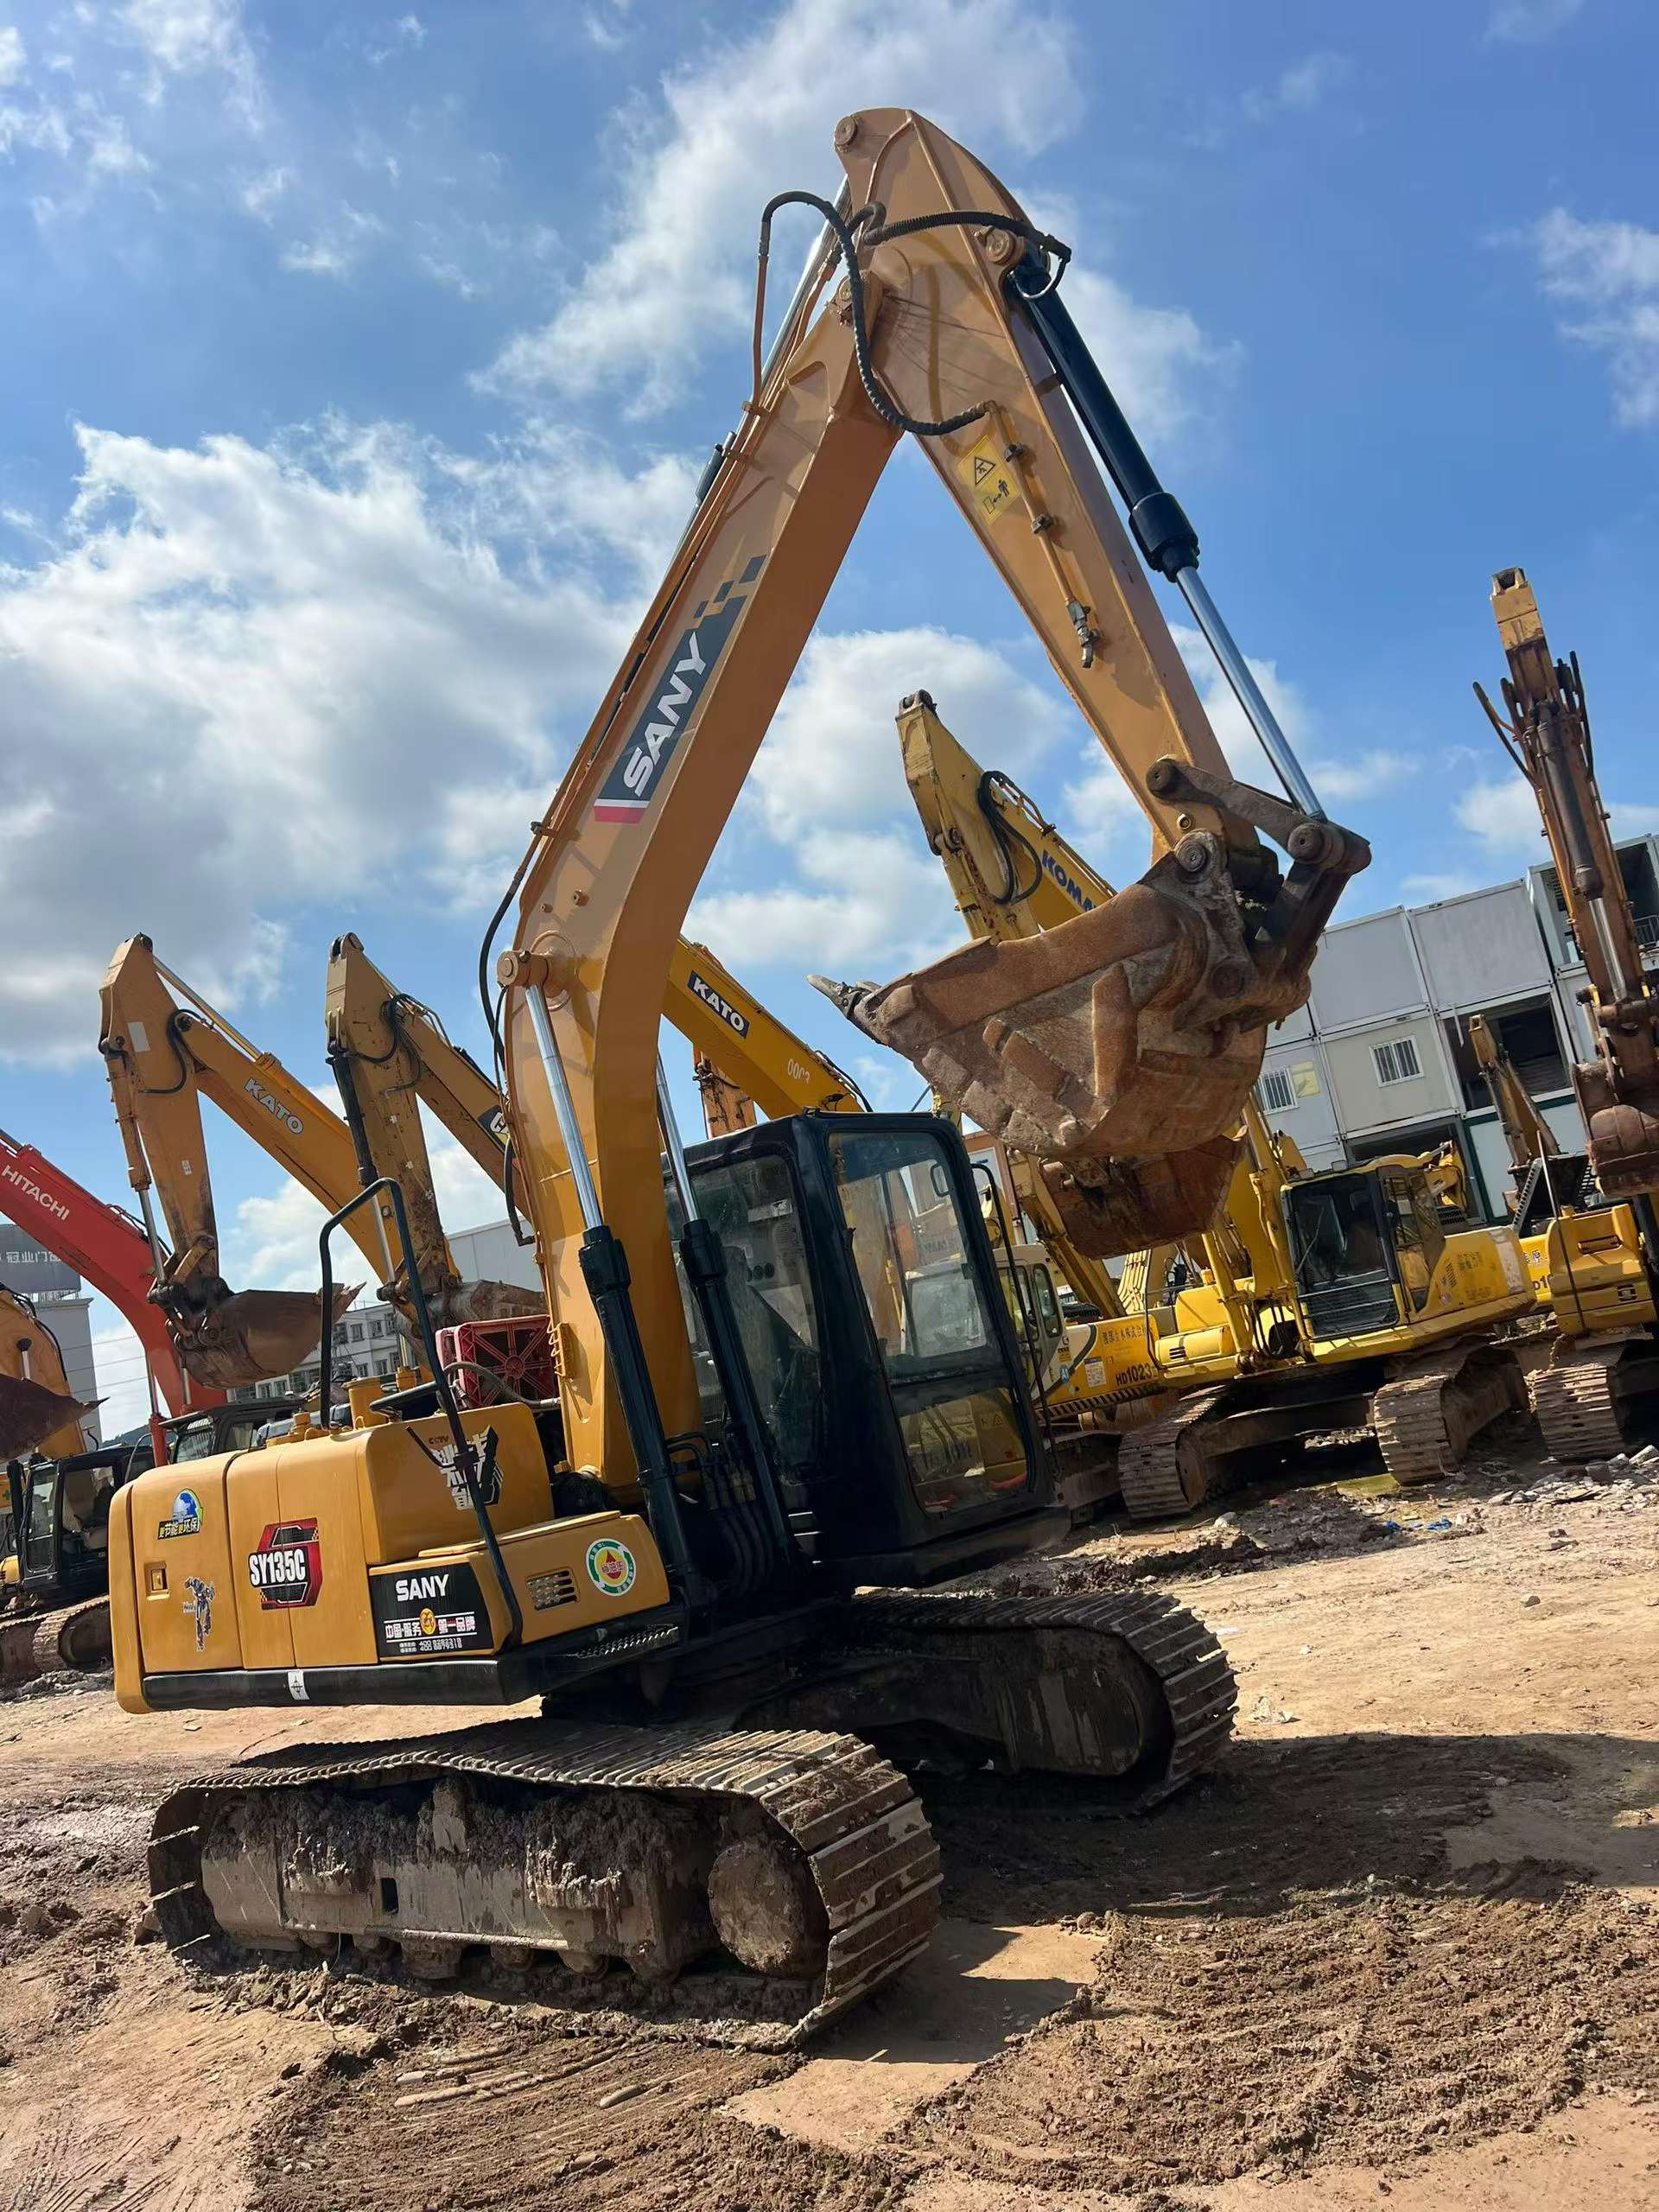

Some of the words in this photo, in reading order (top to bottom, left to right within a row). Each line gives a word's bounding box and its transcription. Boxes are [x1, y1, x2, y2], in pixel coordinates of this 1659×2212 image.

[623, 632, 707, 798] SANY
[1042, 849, 1096, 912] KOMA
[692, 976, 745, 1032] KATO
[244, 1077, 304, 1135] KATO
[2, 1165, 69, 1220] HITACHI
[1116, 1362, 1152, 1387] HD1023
[249, 1548, 306, 1586] SY135C
[396, 1573, 449, 1602] SANY
